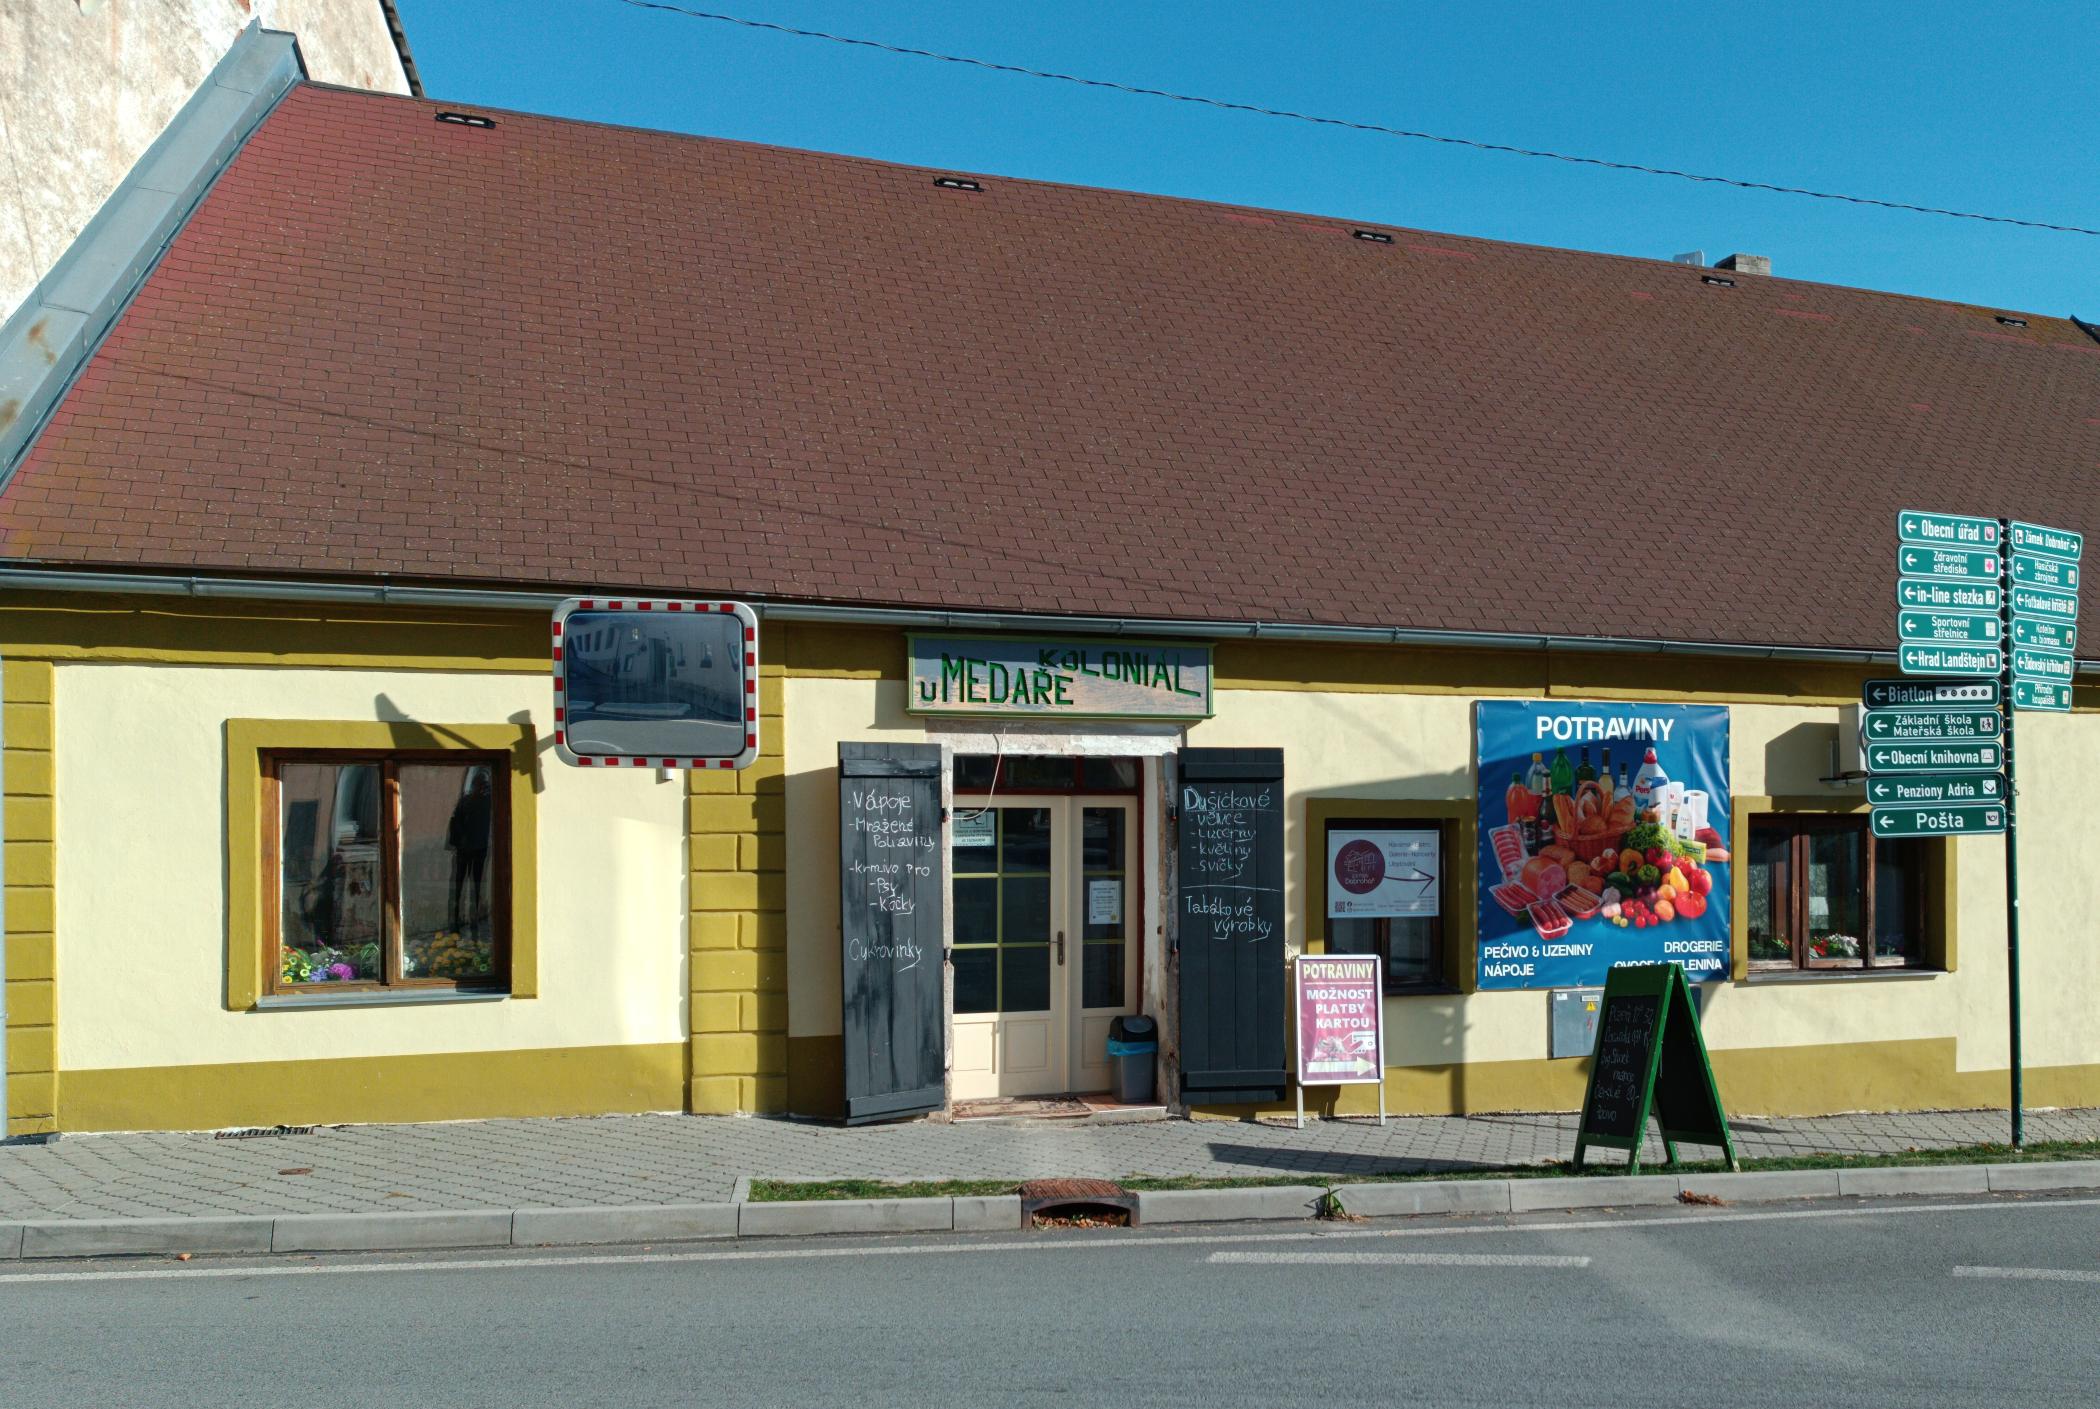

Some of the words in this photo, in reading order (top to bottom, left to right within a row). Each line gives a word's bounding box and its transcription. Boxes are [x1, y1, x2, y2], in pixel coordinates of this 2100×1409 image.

[1921, 519, 1954, 538] Obecní
[1958, 523, 1979, 541] úřad
[2025, 529, 2044, 546] Zámek
[1933, 551, 1968, 563] Zdravotní
[1933, 563, 1968, 575] středisko
[2034, 571, 2059, 585] zbrojnice
[1917, 585, 1950, 604] in-line
[1953, 588, 1984, 605] stezka
[1931, 616, 1970, 630] Sportovní
[1933, 628, 1968, 639] střelnice
[2030, 635, 2038, 644] na
[1918, 650, 1940, 667] Hrad
[1942, 652, 1986, 672] Landštejn
[941, 652, 1075, 706] MEDAŘE
[1888, 685, 1934, 703] Biatlon
[1895, 714, 1939, 725] Základní
[1944, 713, 1972, 724] škola
[1536, 715, 1675, 742] POTRAVINY
[1893, 725, 1942, 737] Mateřská
[1947, 724, 1975, 736] škola
[1891, 750, 1928, 765] Obecní
[1930, 750, 1979, 764] knihovna
[1897, 784, 1943, 800] Penziony
[1948, 783, 1975, 797] Adria
[1916, 811, 1964, 829] Pošta
[1484, 942, 1529, 959] PEČIVO
[1531, 945, 1540, 958] &
[1542, 943, 1594, 957] UZENINY
[1664, 940, 1723, 953] DROGERIE
[1303, 963, 1374, 979] POTRAVINY
[1484, 961, 1535, 977] NÁPOJE
[1306, 987, 1373, 1000] MOŽNOST
[1315, 1003, 1366, 1014] PLATBY
[1316, 1017, 1370, 1029] KARTOU
